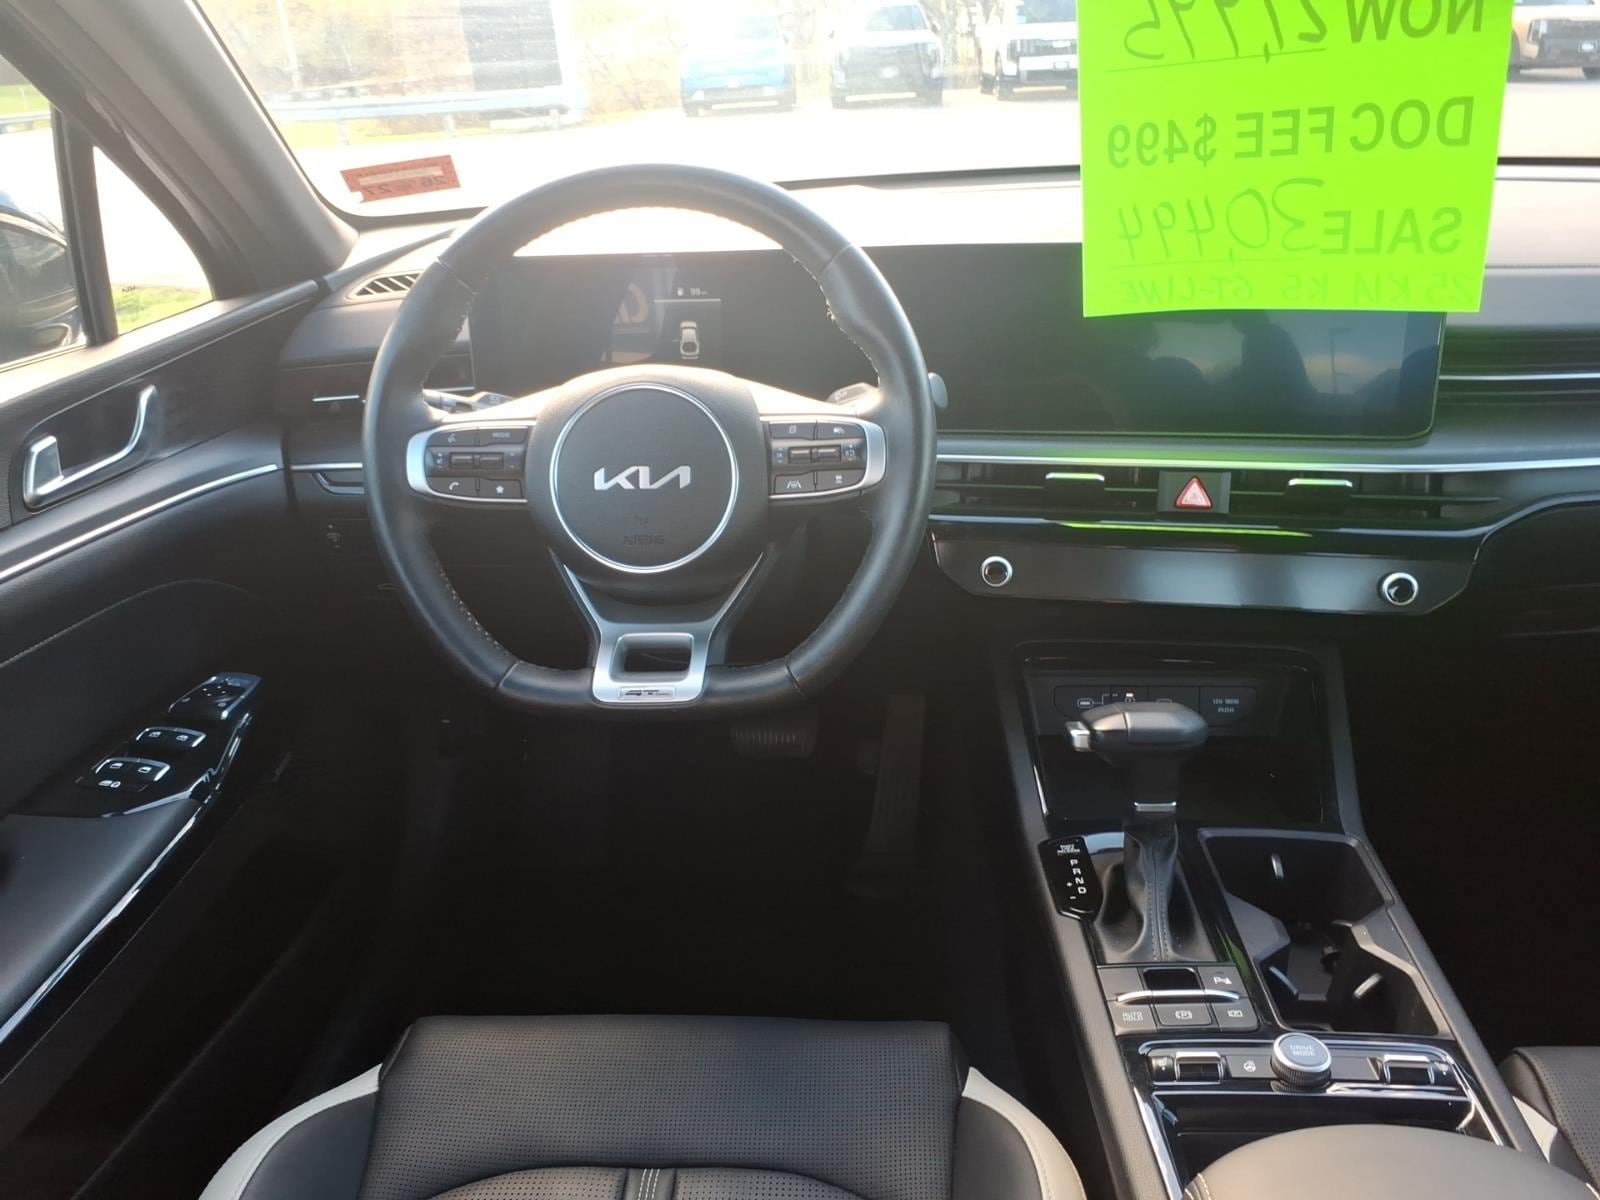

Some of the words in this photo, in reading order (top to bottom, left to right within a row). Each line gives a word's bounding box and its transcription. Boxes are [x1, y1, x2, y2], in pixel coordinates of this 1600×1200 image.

[594, 465, 692, 490] KIA
[1075, 876, 1085, 885] N
[1077, 886, 1087, 894] D
